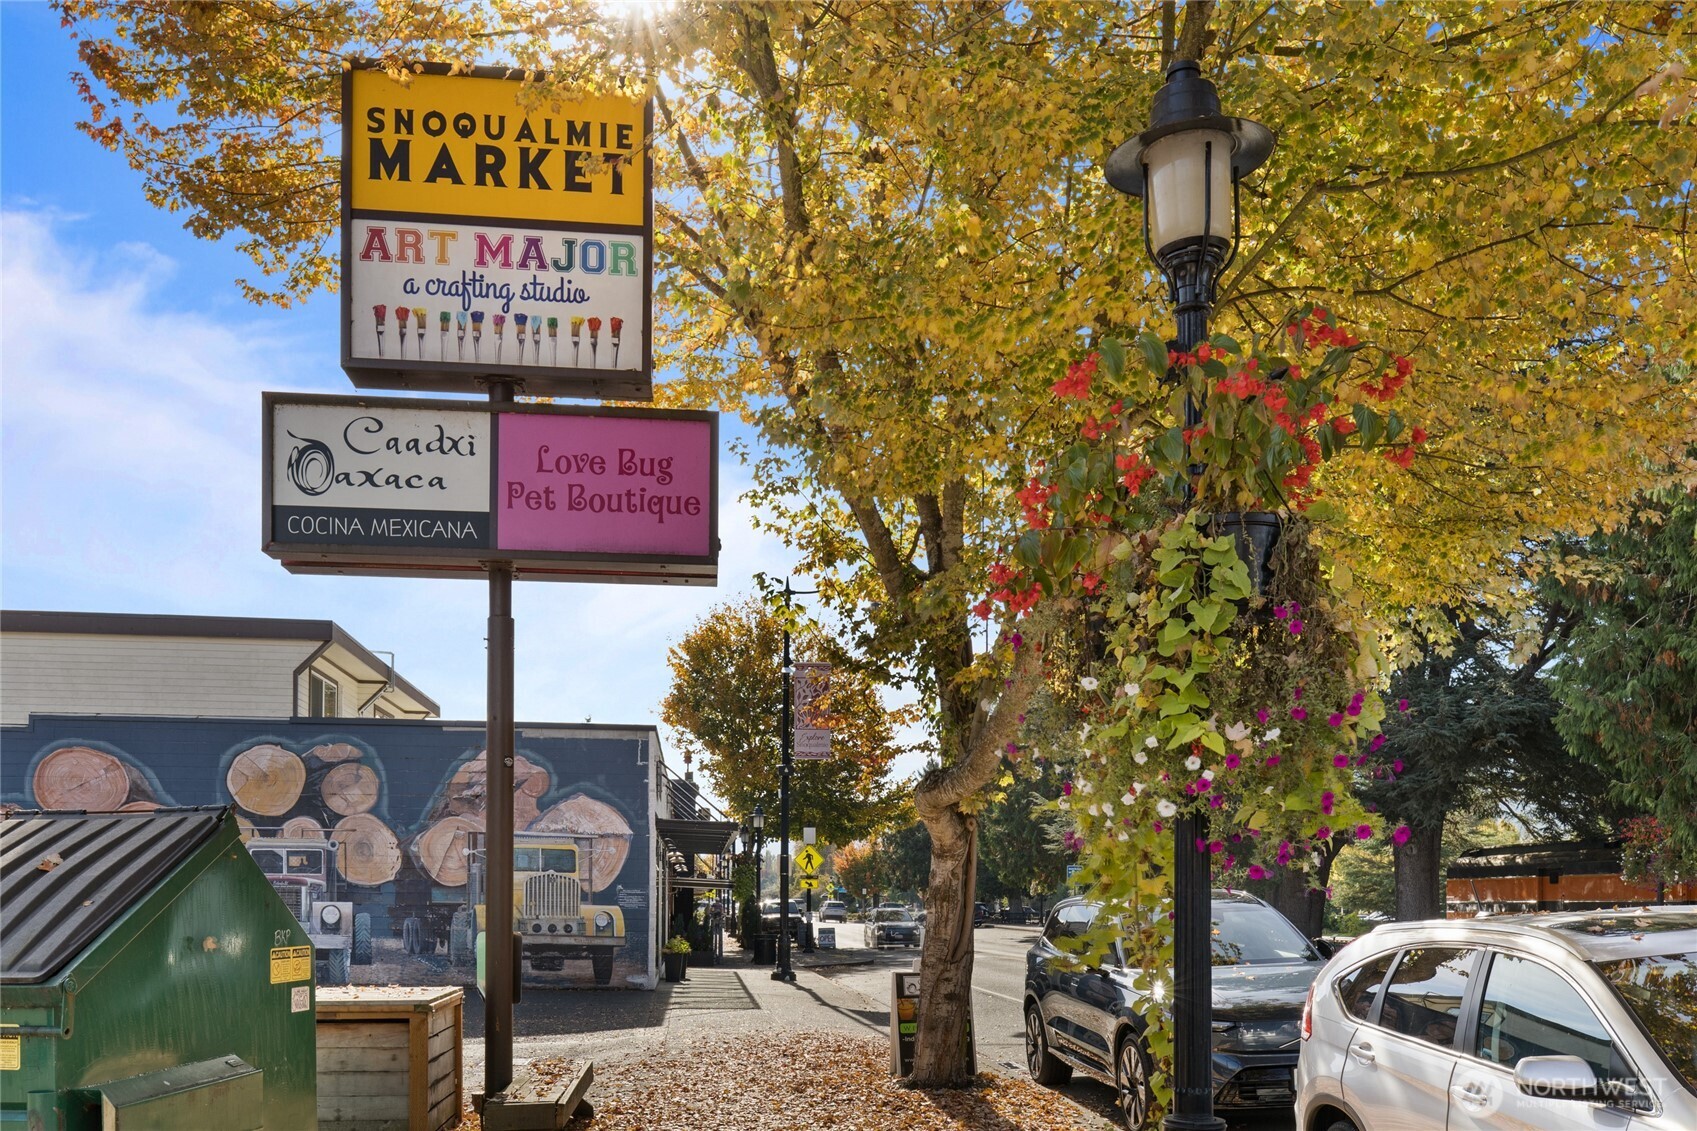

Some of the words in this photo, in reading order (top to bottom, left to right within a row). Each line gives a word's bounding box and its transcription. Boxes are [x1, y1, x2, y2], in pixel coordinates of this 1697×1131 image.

[366, 106, 634, 149] SNOQUALMIE
[368, 138, 633, 195] MARKET
[359, 226, 459, 265] ART
[473, 232, 639, 277] MAJOR
[403, 277, 420, 295] a
[425, 270, 515, 313] crafting
[519, 274, 590, 304] studio
[343, 416, 477, 457] Caadxi
[286, 428, 448, 496] Oaxaca
[535, 444, 606, 475] Love
[617, 448, 674, 485] Bug
[506, 481, 556, 511] Pet
[566, 484, 702, 524] Boutique
[287, 515, 364, 536] COCINA
[370, 517, 478, 540] MEXICANA
[799, 732, 826, 743] Explore
[819, 934, 835, 943] OPEN
